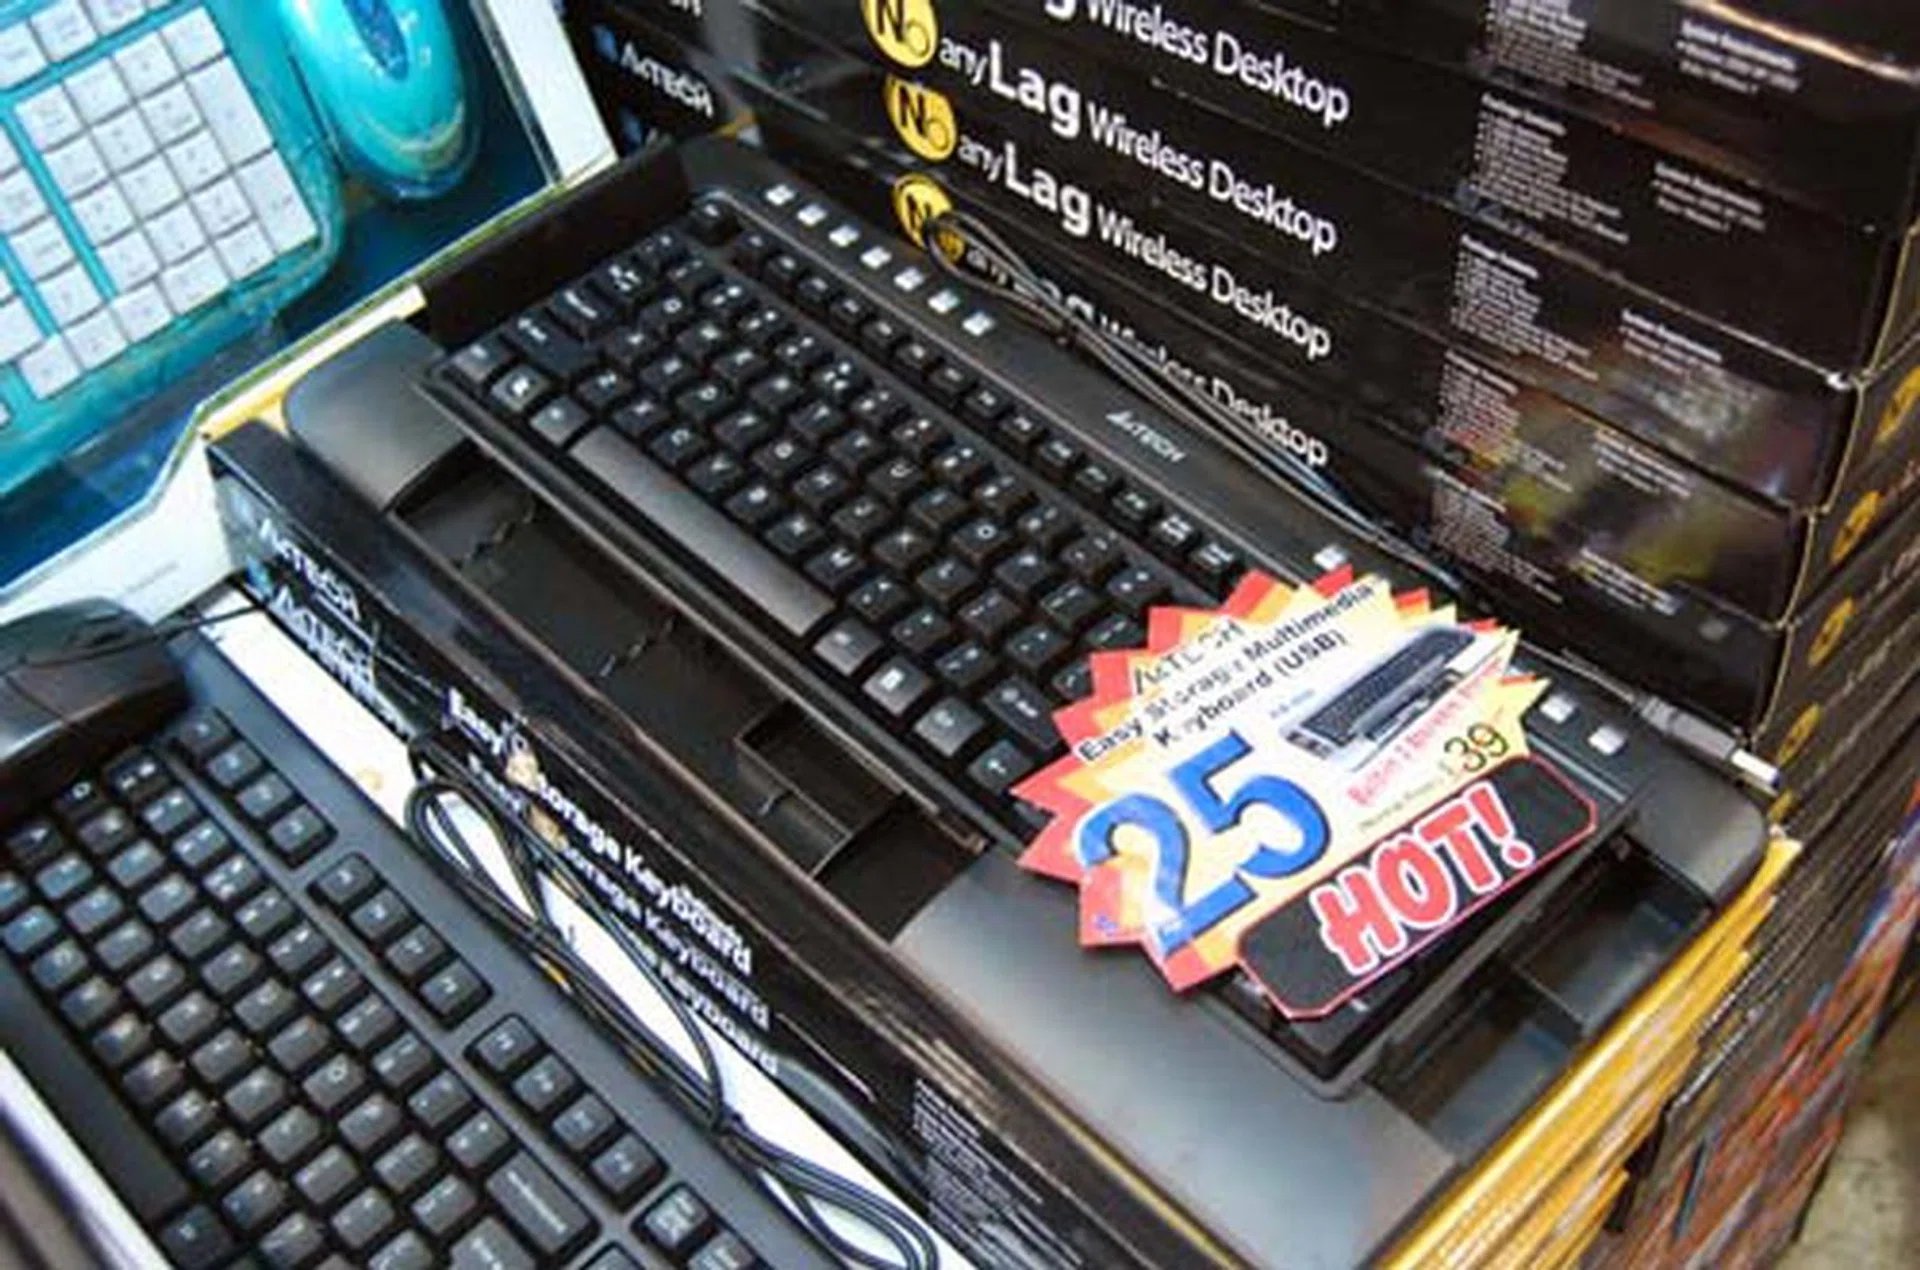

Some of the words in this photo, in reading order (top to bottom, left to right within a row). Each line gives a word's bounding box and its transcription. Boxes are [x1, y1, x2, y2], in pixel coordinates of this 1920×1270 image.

[1212, 29, 1350, 129] Desktop
[1087, 101, 1204, 191] Wireless
[1208, 159, 1338, 257] Desktop
[1097, 204, 1207, 291] Wireless
[1211, 263, 1331, 359] Desktop
[1078, 715, 1145, 762] Easy
[1242, 582, 1376, 662] Multimedia
[624, 846, 753, 976] Keyboard
[1079, 730, 1332, 955] 25
[1312, 783, 1535, 973] HOT!
